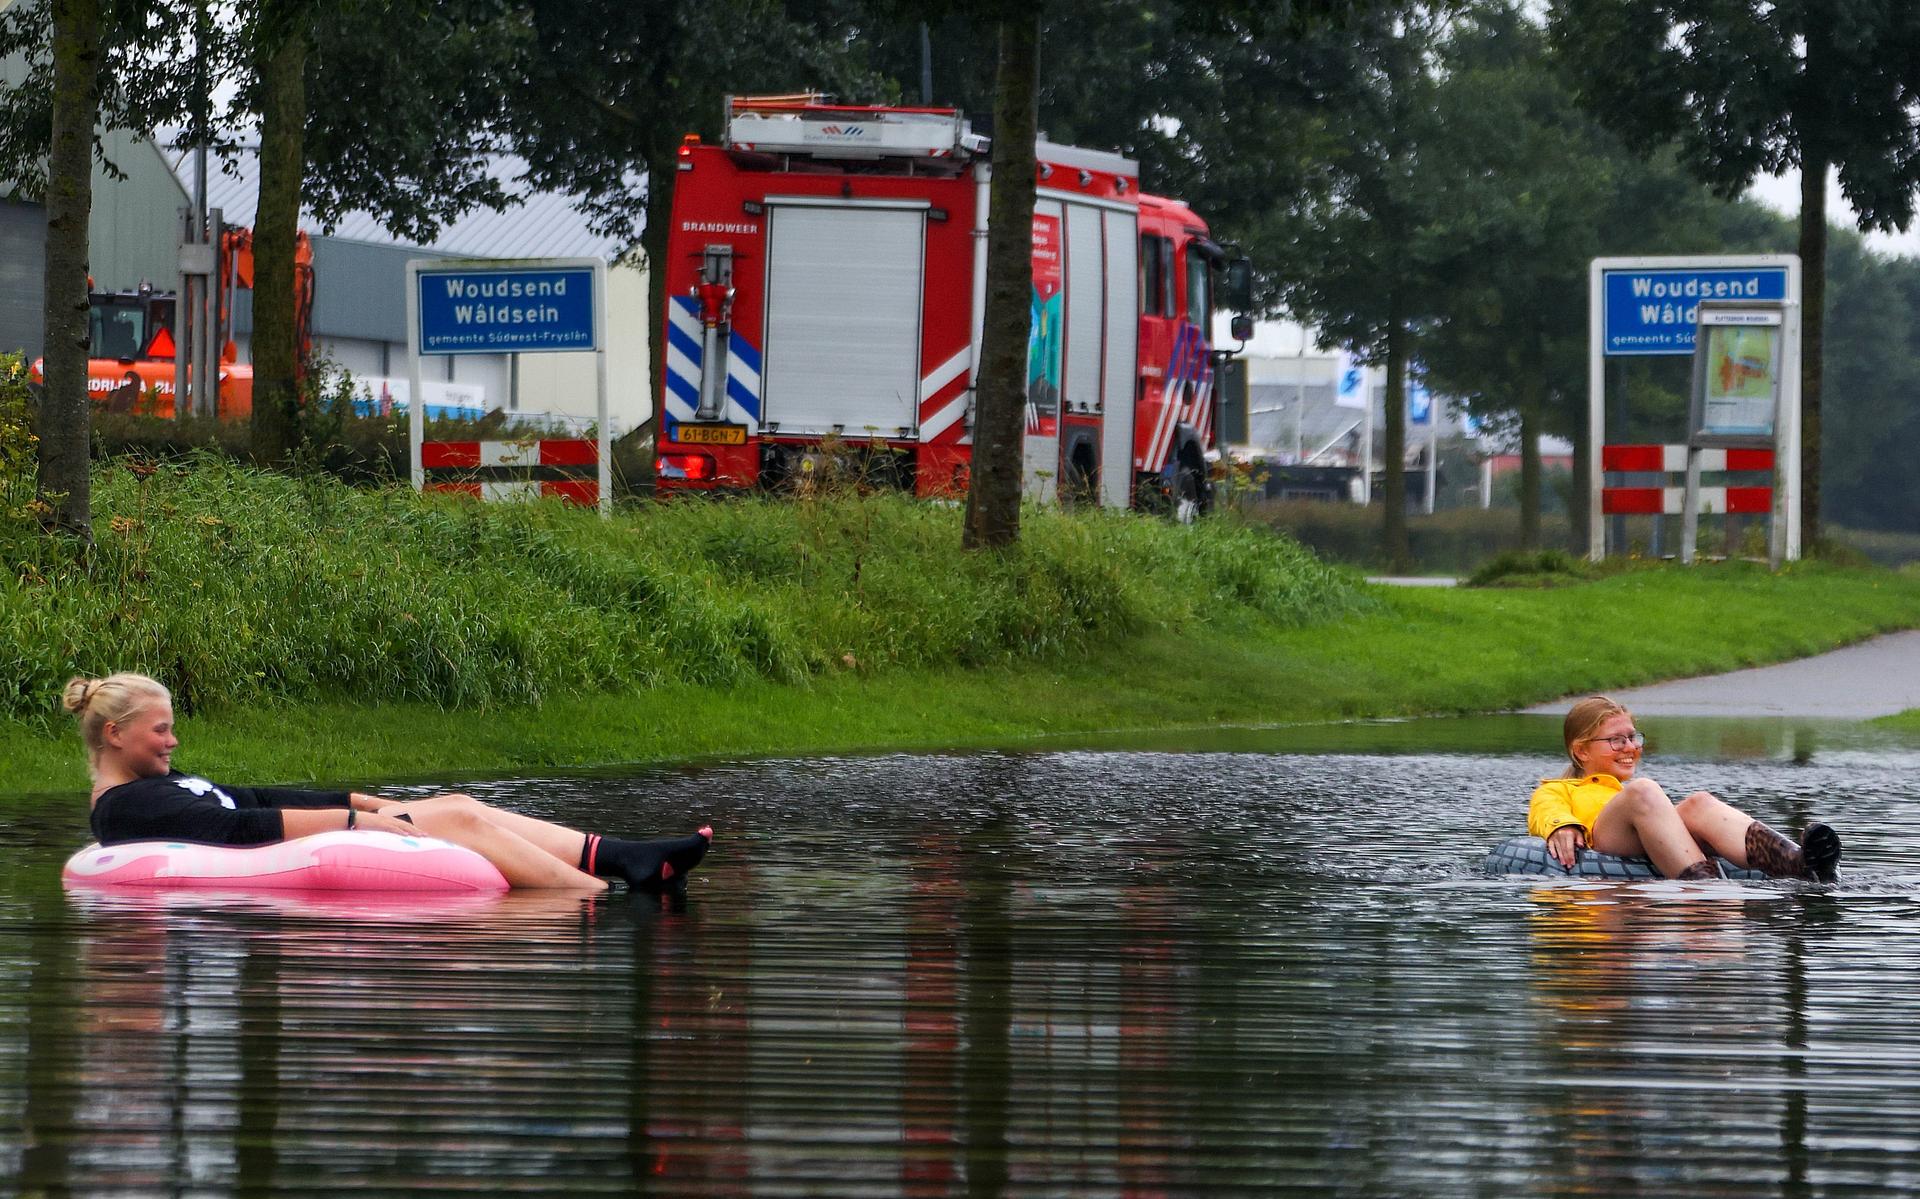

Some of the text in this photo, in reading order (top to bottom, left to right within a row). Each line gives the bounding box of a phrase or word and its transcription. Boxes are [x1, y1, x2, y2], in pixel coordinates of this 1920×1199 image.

[682, 221, 758, 234] BRANDWEER
[446, 278, 566, 298] Woudsend
[1632, 277, 1759, 297] Woudsend
[455, 303, 559, 325] Wâldsein
[1641, 303, 1698, 324] Wâld
[428, 333, 484, 346] gemeente
[1613, 335, 1671, 346] gemeente
[684, 429, 740, 442] 61-BGN-7
